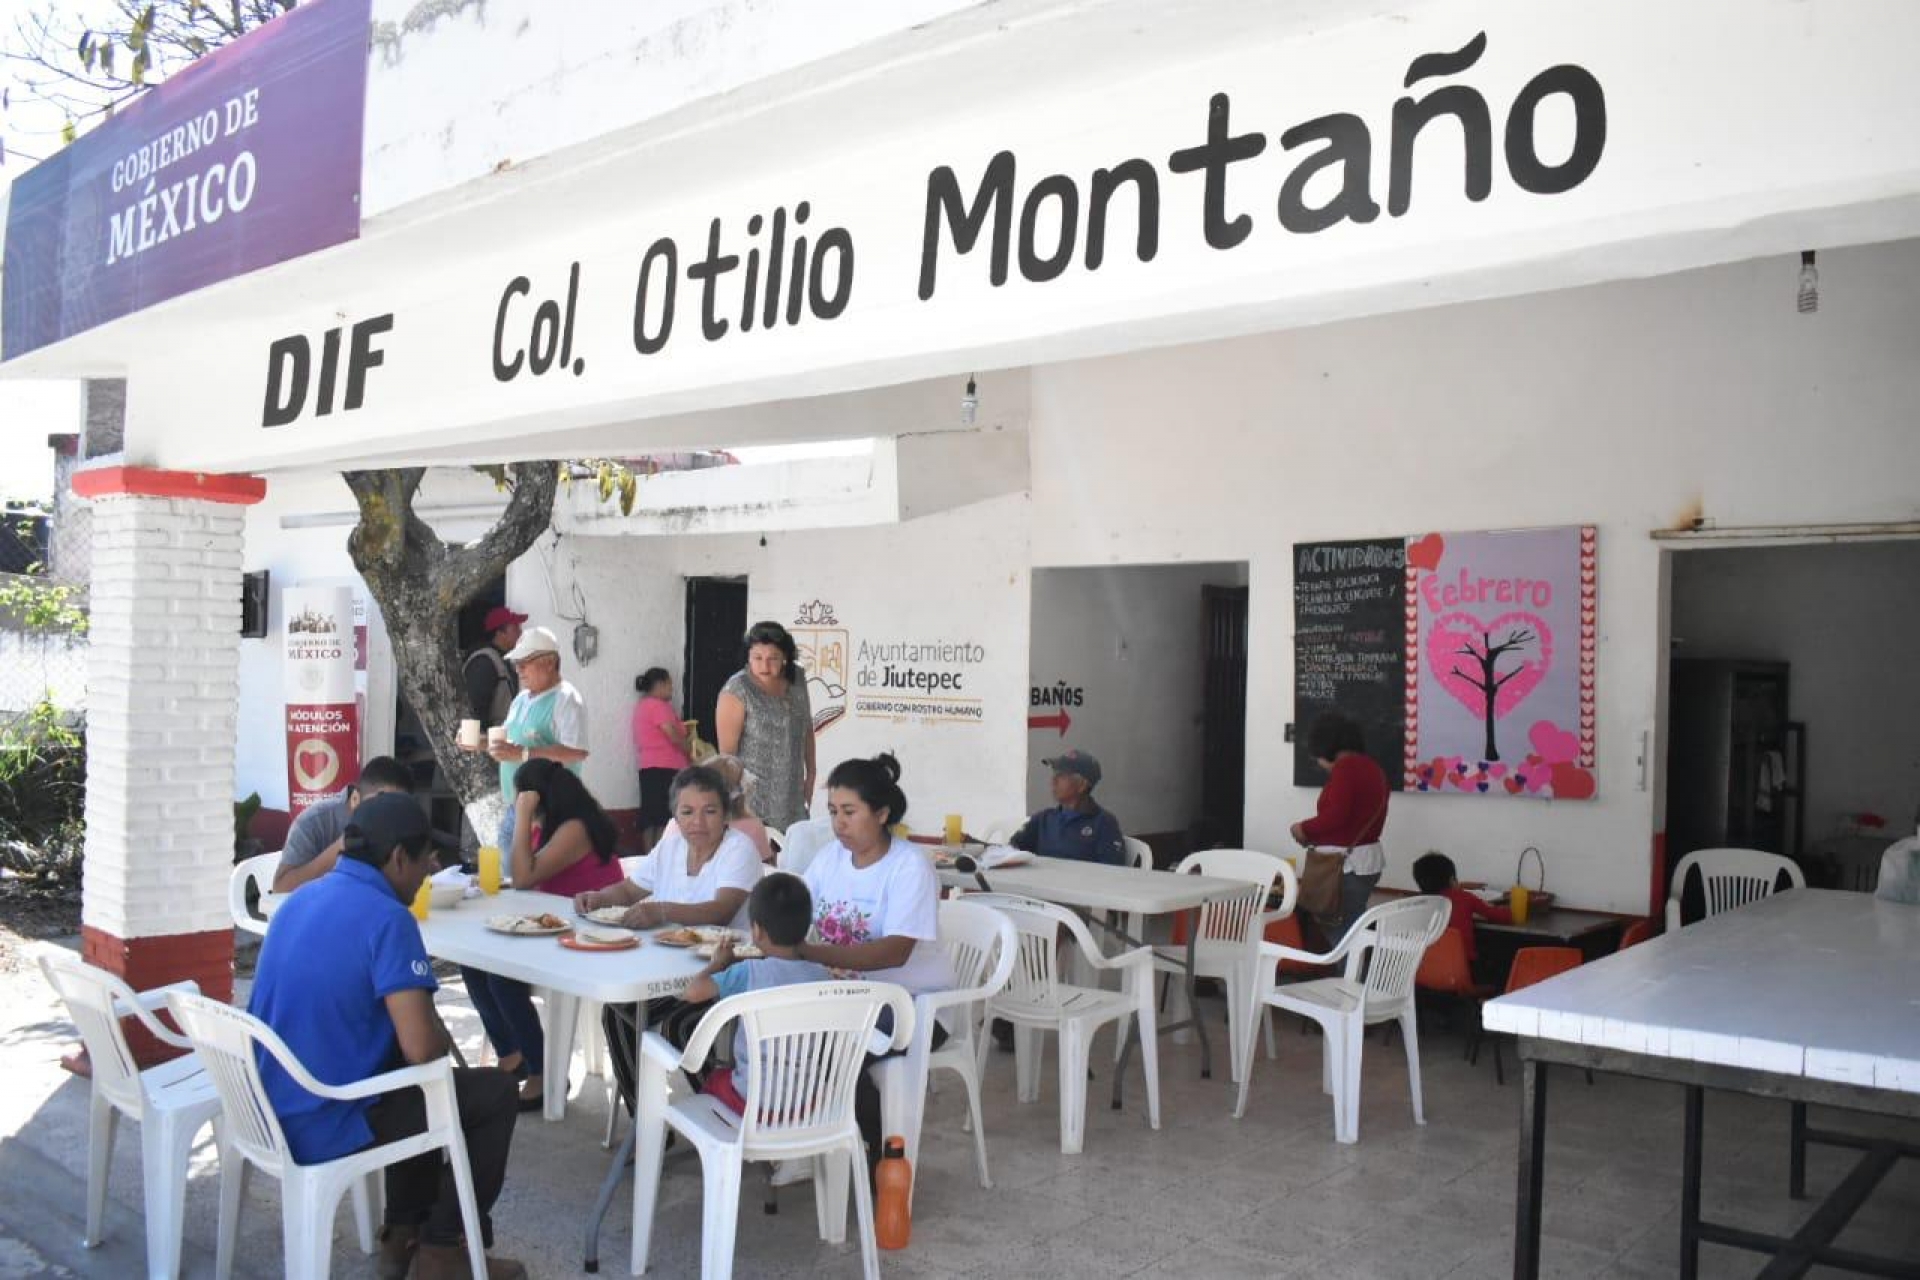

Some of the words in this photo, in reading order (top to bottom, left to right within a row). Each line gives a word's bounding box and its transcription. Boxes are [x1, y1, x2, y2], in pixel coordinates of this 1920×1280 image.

[111, 108, 219, 192] GOBIERNO
[224, 87, 259, 136] DE
[106, 150, 256, 265] MÉXICO
[262, 313, 394, 428] DIF
[492, 260, 585, 382] Col.
[633, 200, 855, 355] Otilio
[918, 30, 1607, 301] Montaño
[1420, 567, 1552, 613] Febrero
[857, 638, 984, 666] Ayuntamiento
[857, 665, 878, 687] de
[881, 665, 962, 695] Jiutepec
[1031, 679, 1084, 706] BAÑOS
